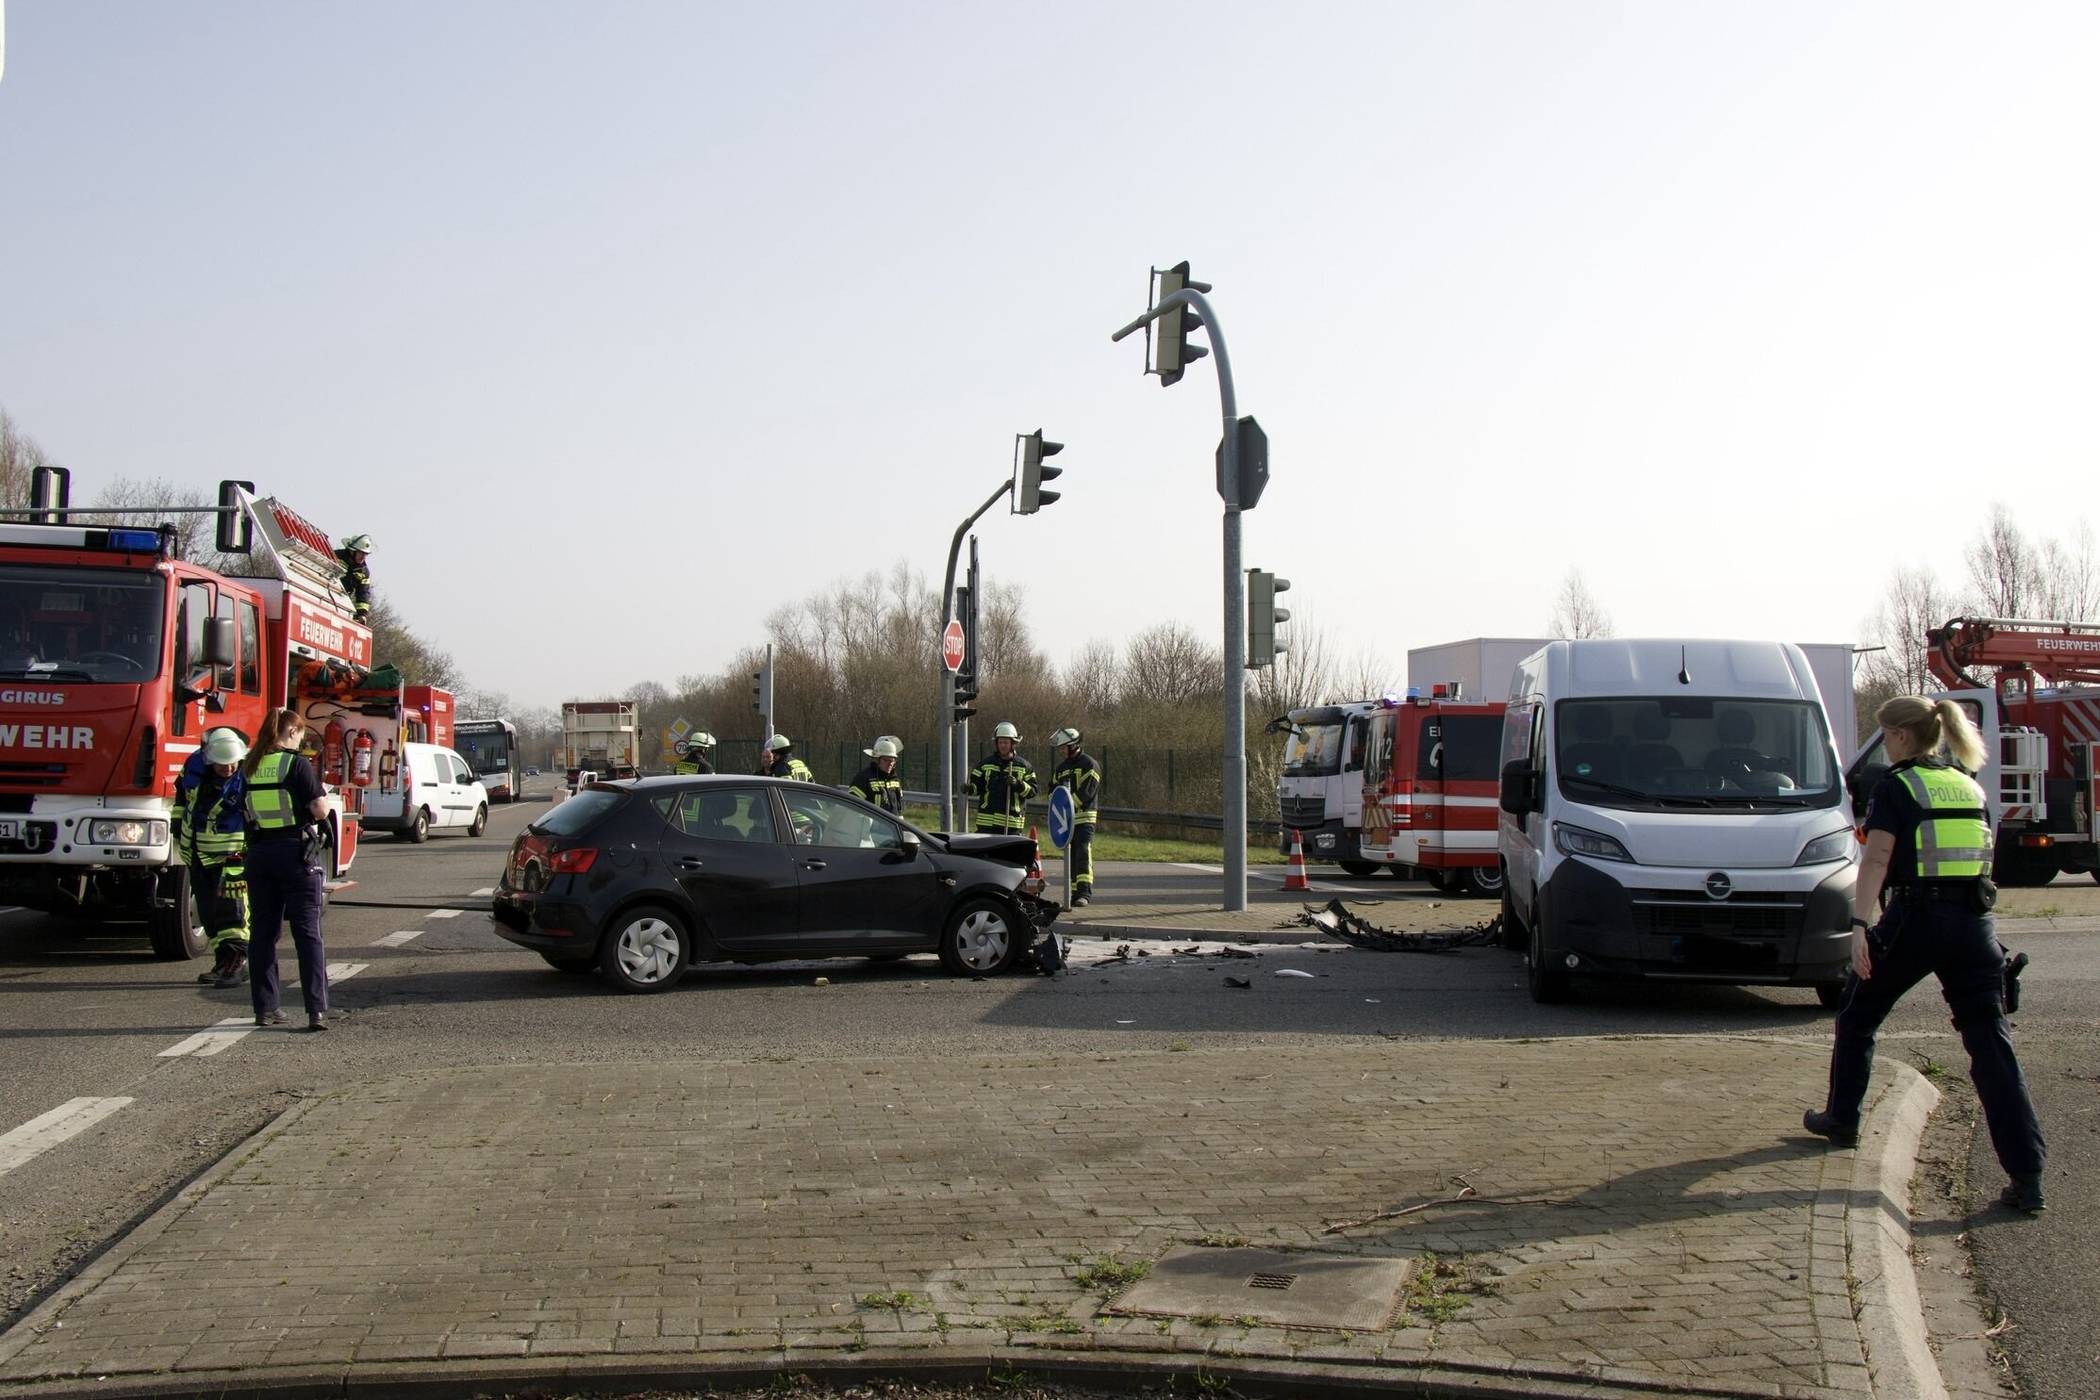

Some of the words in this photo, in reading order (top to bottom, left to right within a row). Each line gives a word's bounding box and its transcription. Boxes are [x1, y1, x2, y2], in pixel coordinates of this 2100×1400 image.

[301, 616, 343, 654] FEUERWEHR
[946, 636, 962, 656] STOP
[0, 690, 65, 705] GIRUS
